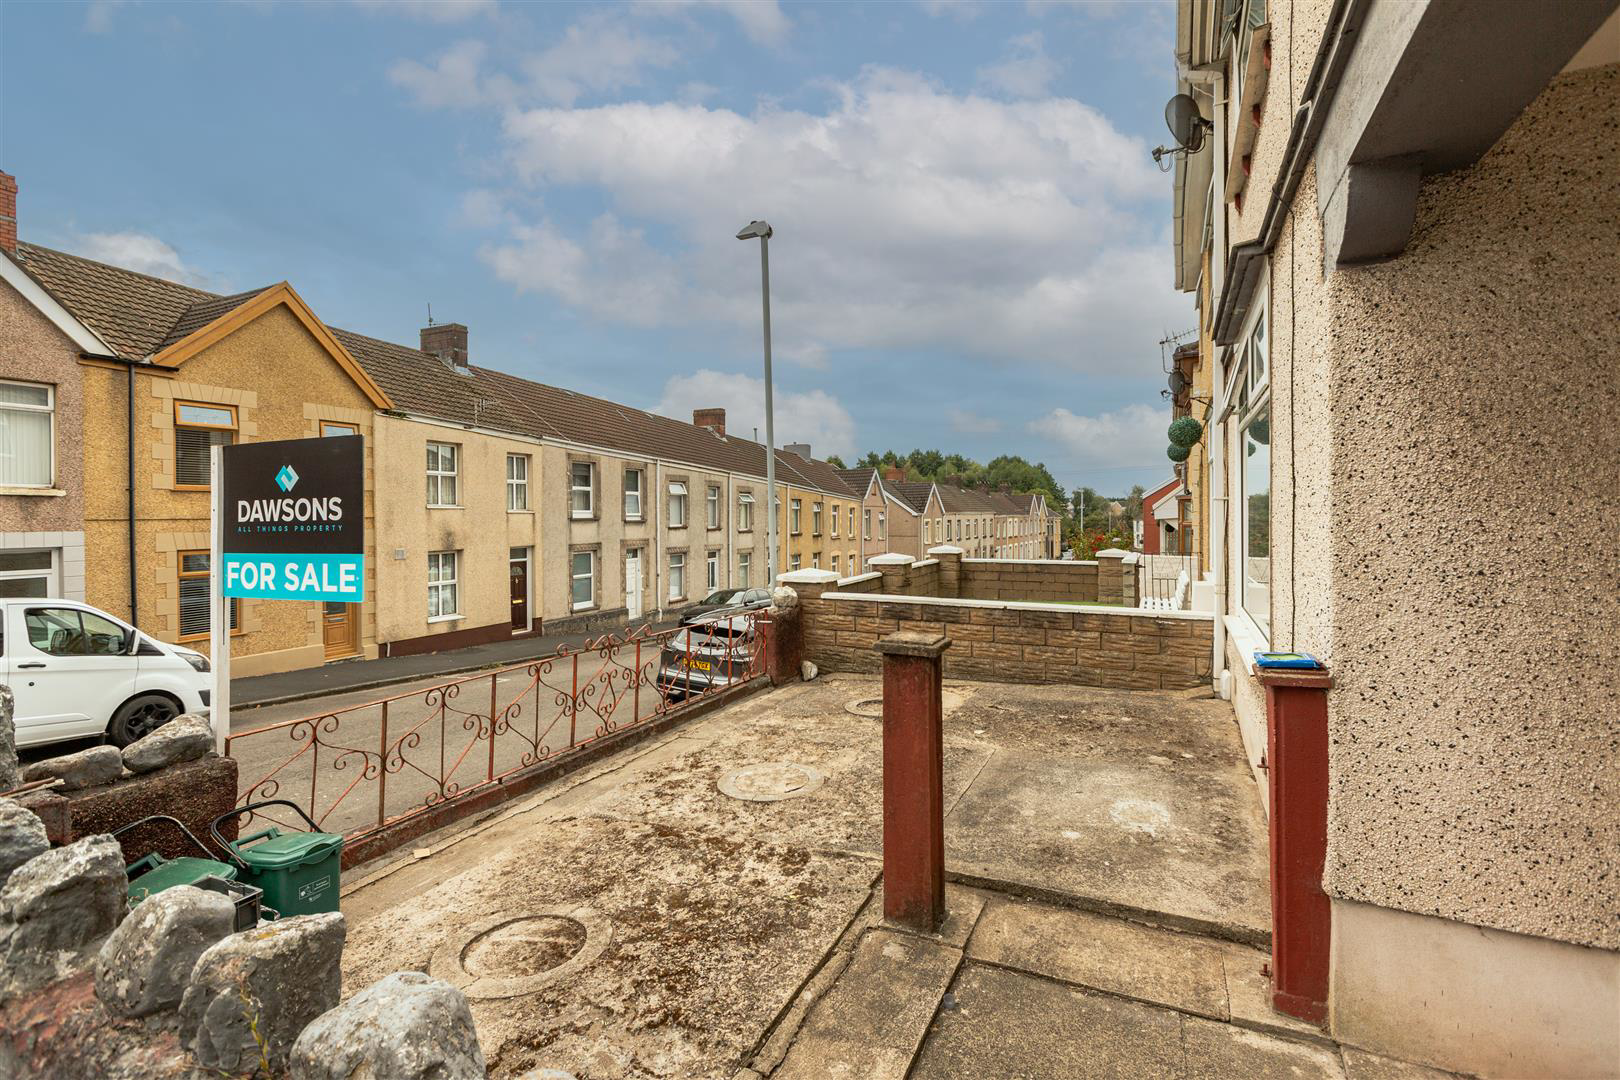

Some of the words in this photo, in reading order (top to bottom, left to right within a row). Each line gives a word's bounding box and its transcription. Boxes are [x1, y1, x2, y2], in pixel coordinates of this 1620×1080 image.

[238, 496, 343, 522] DAWSONS
[257, 525, 289, 533] THINGS
[294, 524, 343, 532] PROPERTY
[227, 562, 276, 590] FOR
[284, 562, 357, 593] SALE
